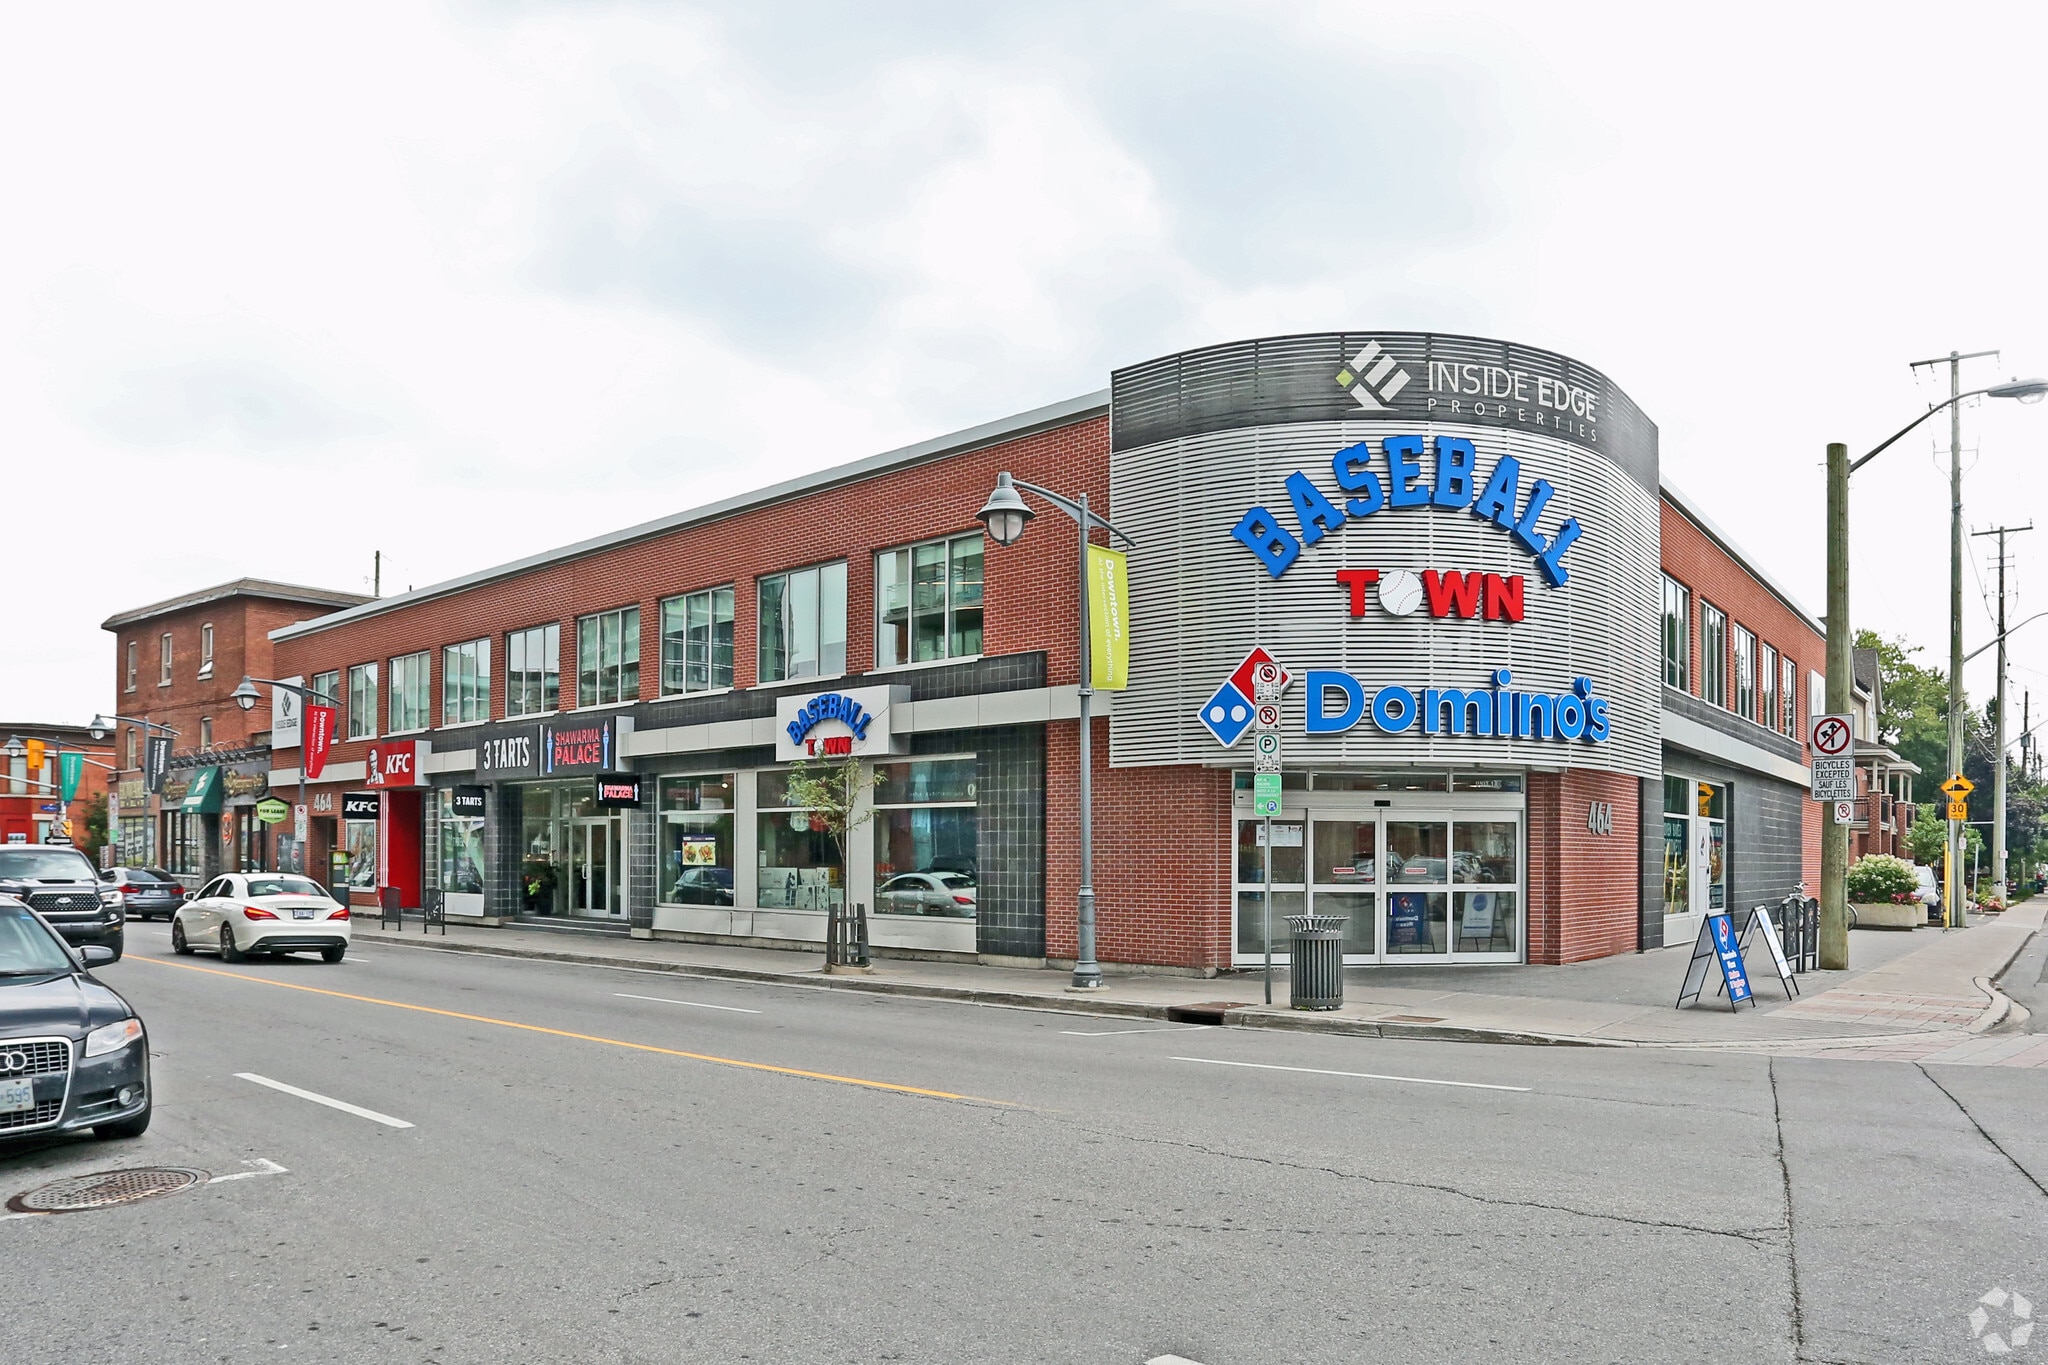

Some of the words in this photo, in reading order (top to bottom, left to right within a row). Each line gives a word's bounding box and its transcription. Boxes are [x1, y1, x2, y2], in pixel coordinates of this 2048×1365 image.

[1428, 361, 1529, 402] INSIDE
[1538, 376, 1597, 423] EDGE
[1427, 397, 1597, 442] PROPERTIES
[1230, 434, 1583, 588] BASEBALL
[1304, 667, 1611, 743] Domino's
[787, 693, 872, 746] BASEBALL
[554, 728, 600, 746] SHAWARMA
[483, 740, 491, 770] 3
[493, 735, 530, 769] TARTS
[554, 742, 600, 766] PALACE
[385, 753, 411, 775] KFC
[1816, 761, 1850, 770] BICYCLES
[1816, 770, 1850, 779] EXCEPTED
[1815, 789, 1851, 799] BICYCLETTES
[1819, 780, 1834, 789] SAUF
[1836, 780, 1847, 789] LES
[314, 792, 332, 812] 464
[456, 796, 461, 805] 3
[462, 796, 482, 806] TARTS
[604, 790, 634, 799] PALACE
[345, 800, 378, 813] KFC
[1951, 804, 1964, 813] 30
[1587, 801, 1613, 836] 464
[6, 1086, 31, 1104] 595
